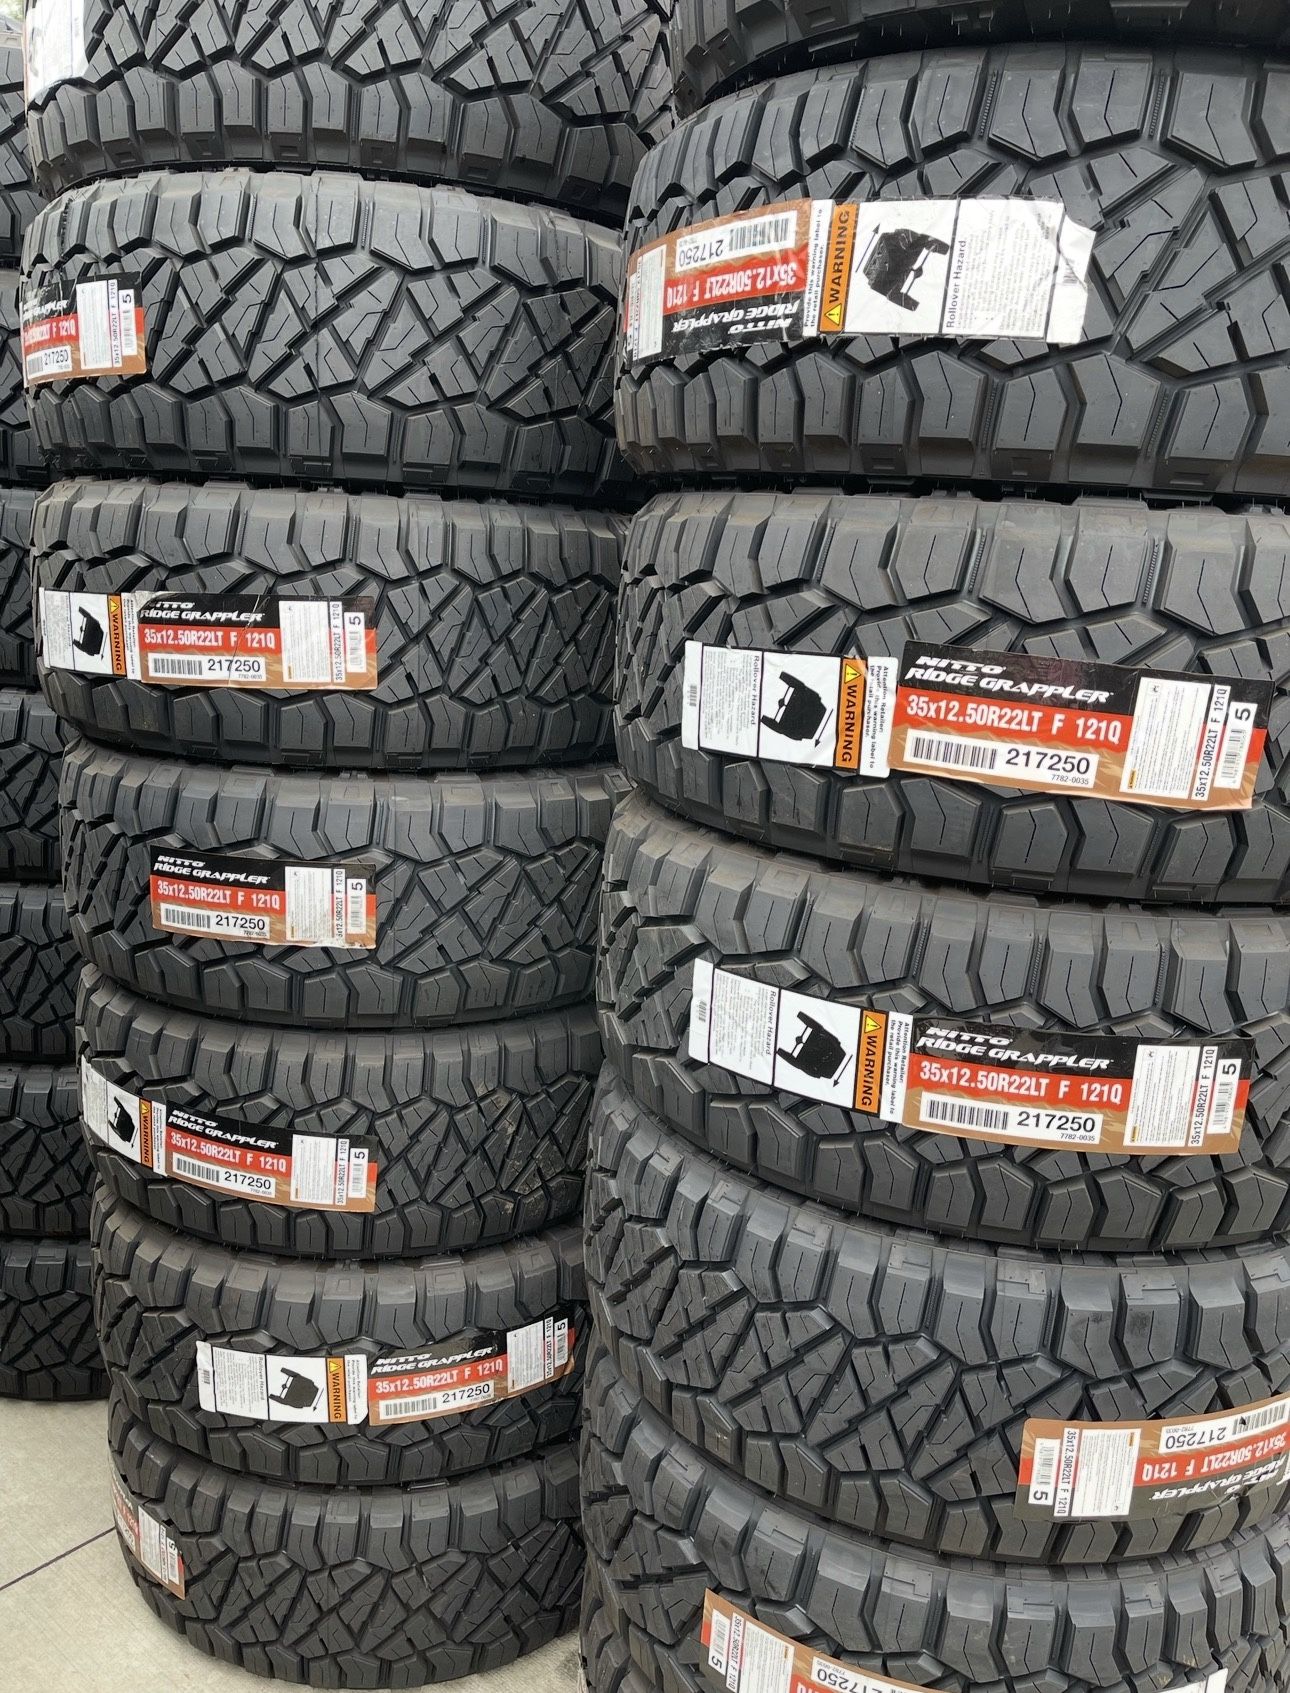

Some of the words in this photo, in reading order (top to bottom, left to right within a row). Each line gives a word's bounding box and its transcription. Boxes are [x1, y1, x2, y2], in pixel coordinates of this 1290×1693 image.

[679, 240, 724, 268] 217250
[829, 210, 850, 304] WARNING
[704, 262, 797, 300] 35x12.50R22LT
[946, 280, 961, 328] Rollover
[954, 240, 967, 279] Hazard
[122, 293, 132, 304] 5
[666, 282, 688, 309] 121Q
[671, 307, 744, 333] GRAPPLER
[745, 299, 801, 318] RIDGE
[140, 608, 180, 620] RIDGE
[181, 610, 262, 622] GRAPPLER
[349, 616, 362, 626] 5
[112, 613, 122, 672] WARNING
[144, 628, 224, 646] 35x12.50R22LT
[230, 632, 238, 647] F
[246, 632, 276, 650] 121Q
[208, 658, 260, 673] 217250
[916, 655, 1004, 675] NITTO
[905, 667, 978, 686] RIDGE
[980, 676, 1110, 704] GRAPPLER
[750, 695, 758, 725] Hazard
[906, 694, 1043, 733] 35x12.50R22LT
[1052, 714, 1065, 736] F
[1076, 717, 1122, 744] 121Q
[1235, 708, 1250, 722] 5
[842, 684, 858, 762] WARNING
[1195, 730, 1218, 798] 35x12.50R22LT
[1214, 688, 1228, 712] 121Q
[1006, 748, 1090, 776] 217250
[1052, 774, 1089, 786] 7782-0035
[154, 862, 192, 876] RIDGE
[192, 869, 268, 884] GRAPPLER
[158, 855, 204, 868] NITTO
[158, 880, 232, 904] 35x12.50R22LT
[238, 892, 244, 906] F
[251, 892, 280, 911] 121Q
[352, 882, 363, 891] 5
[216, 914, 266, 930] 217250
[336, 897, 344, 940] 5x12.50R22LT
[768, 990, 777, 1024] Rollover
[765, 1026, 774, 1056] Hazard
[902, 1022, 910, 1054] Attention
[926, 1026, 1012, 1046] NITTO
[916, 1036, 987, 1056] RIDGE
[988, 1045, 1110, 1070] GRAPPLER
[862, 1035, 878, 1106] WARNING
[890, 1062, 898, 1088] warning
[920, 1060, 1050, 1097] 35x12.50R22LT
[1058, 1080, 1070, 1099] F
[1080, 1082, 1122, 1104] 121Q
[1222, 1064, 1237, 1076] 5
[1191, 1084, 1208, 1144] 35x12.50R22LT
[1204, 1049, 1215, 1070] 121Q
[172, 1110, 218, 1127] NITTO
[1016, 1110, 1096, 1134] 217250
[168, 1115, 204, 1132] RIDGE
[204, 1127, 277, 1150] GRAPPLER
[1060, 1132, 1096, 1142] 7782-0035
[171, 1132, 241, 1164] 35x12.50R22LT
[246, 1152, 254, 1166] F
[259, 1156, 286, 1173] 121Q
[354, 1151, 366, 1160] 5
[224, 1170, 271, 1190] 217250
[558, 1322, 566, 1330] 5
[370, 1362, 417, 1375] RIDGE
[418, 1346, 492, 1369] GRAPPLER
[376, 1353, 431, 1366] NITTO
[376, 1370, 458, 1394] 35x12.50R22LT
[464, 1367, 472, 1380] F
[332, 1372, 342, 1420] WARNING
[442, 1384, 490, 1404] 217250
[1166, 1426, 1227, 1450] 217250
[1062, 1430, 1077, 1484] 35x12.50R22LT
[1184, 1459, 1195, 1476] F
[1142, 1462, 1178, 1482] 121Q
[1033, 1490, 1048, 1501] 5
[1152, 1474, 1242, 1500] GRAPPLER
[1056, 1498, 1068, 1514] 121Q
[168, 1540, 176, 1552] 5
[712, 1656, 722, 1670] 5
